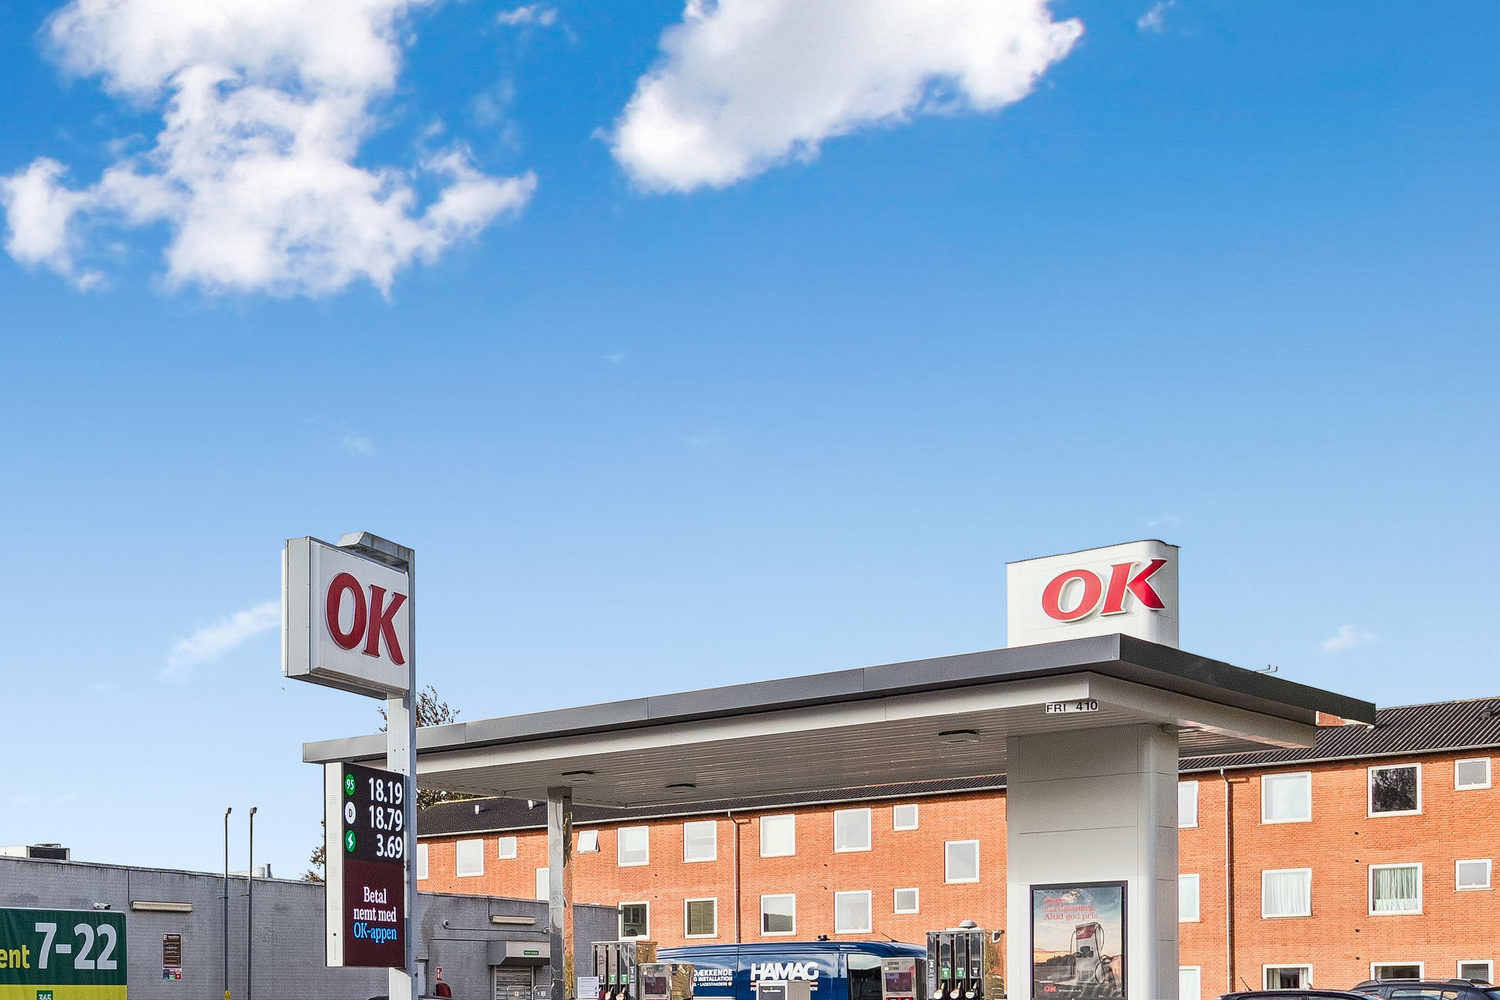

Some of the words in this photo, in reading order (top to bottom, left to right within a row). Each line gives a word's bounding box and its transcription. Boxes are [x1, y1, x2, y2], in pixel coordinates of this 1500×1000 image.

[1042, 558, 1167, 622] OK
[326, 572, 407, 666] OK
[1047, 704, 1066, 713] FRI
[1076, 701, 1098, 711] 410
[346, 779, 354, 790] 95
[369, 777, 403, 805] 18.19
[369, 805, 403, 832] 18.79
[376, 833, 403, 859] 3.69
[363, 886, 387, 904] Betal
[353, 907, 377, 921] nemt
[378, 906, 397, 922] med
[35, 922, 118, 970] 7-22
[353, 922, 398, 944] OK-appen
[750, 961, 820, 981] HAMAG
